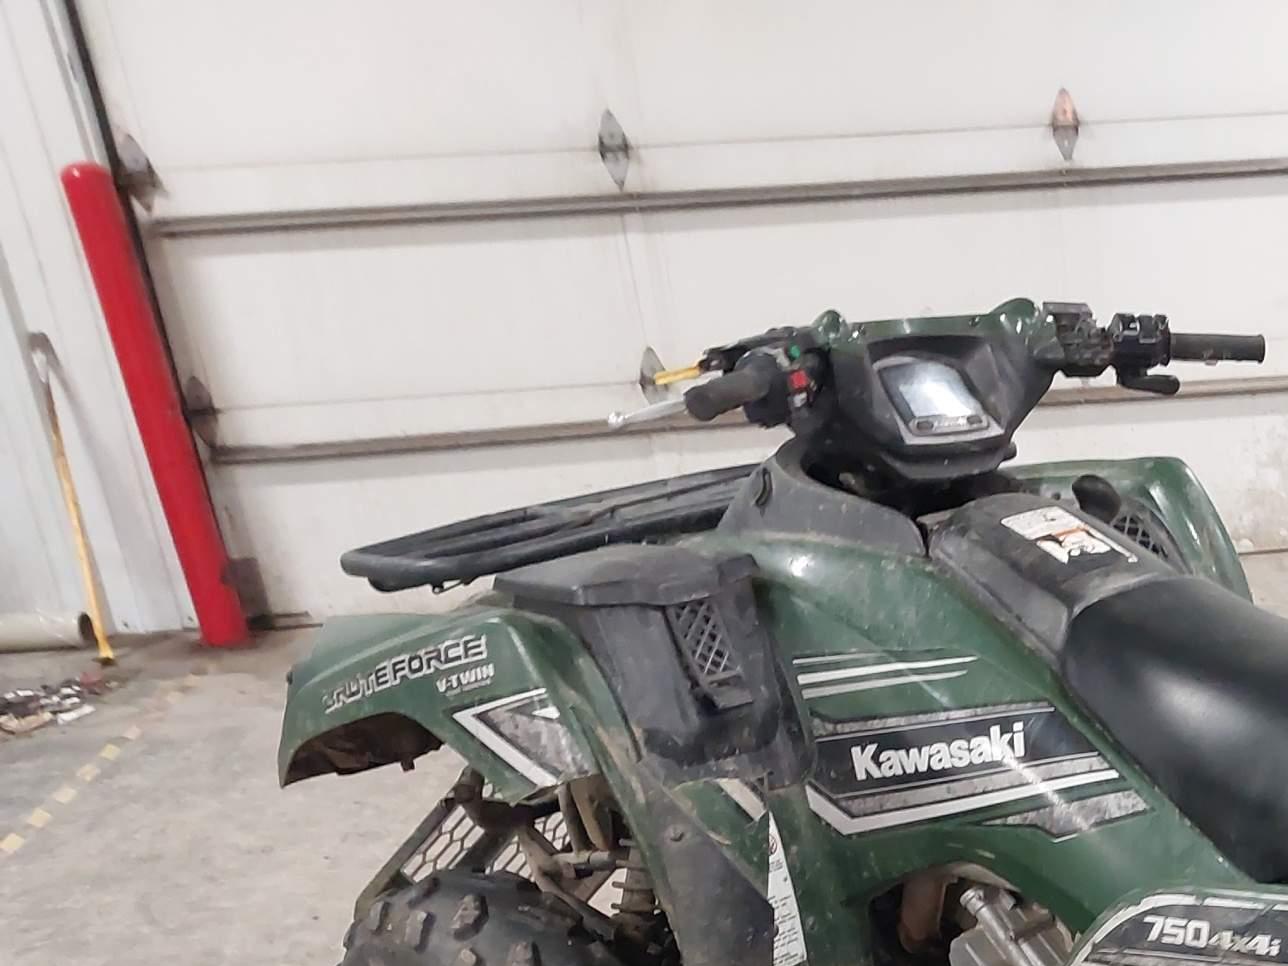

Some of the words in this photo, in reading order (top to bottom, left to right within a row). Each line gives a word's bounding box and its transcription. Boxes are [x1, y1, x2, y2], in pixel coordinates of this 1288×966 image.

[435, 662, 496, 694] V-TWIN
[850, 720, 1026, 782] Kawasaki
[1143, 914, 1211, 949] 750
